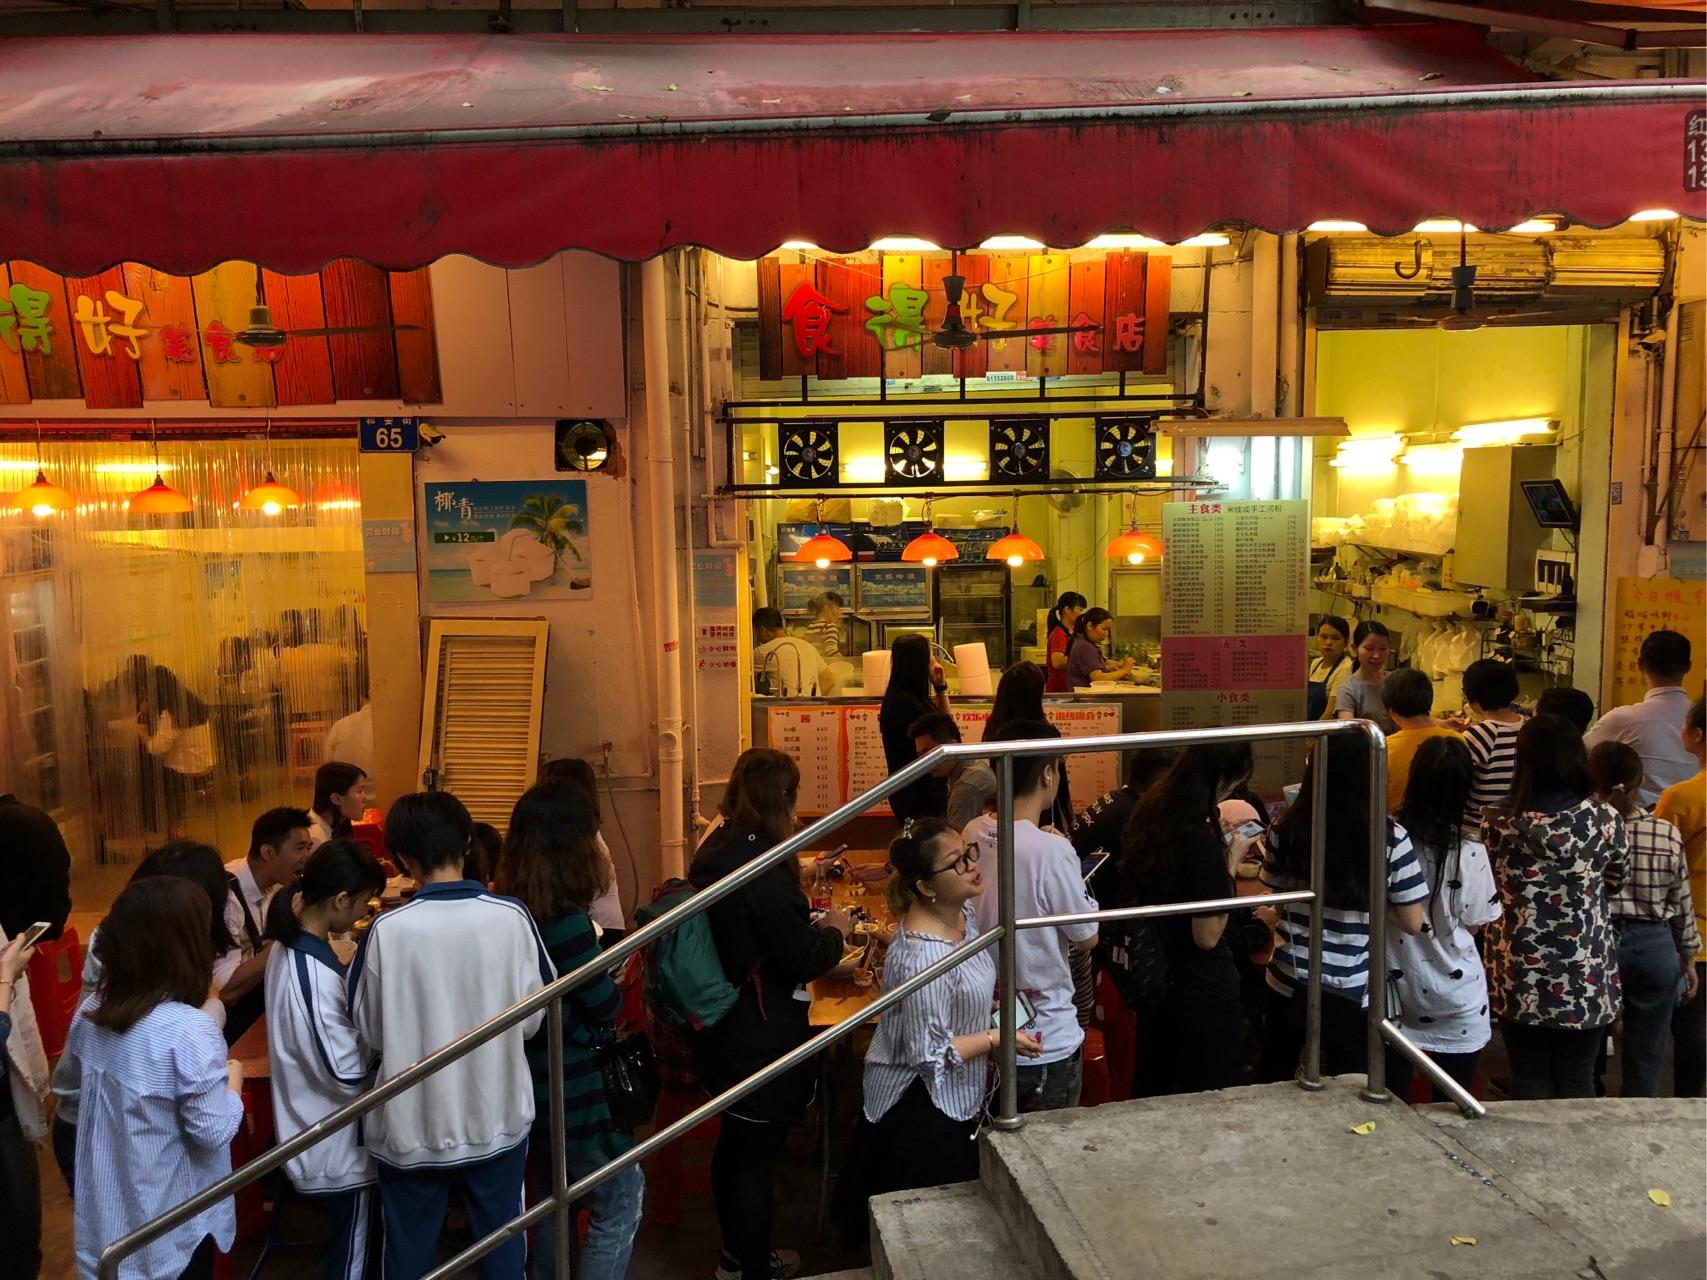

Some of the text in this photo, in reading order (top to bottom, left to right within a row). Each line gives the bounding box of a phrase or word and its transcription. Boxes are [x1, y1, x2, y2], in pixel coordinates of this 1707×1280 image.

[375, 427, 403, 448] 65
[433, 490, 474, 520] 椰青
[1187, 503, 1222, 514] 主食类
